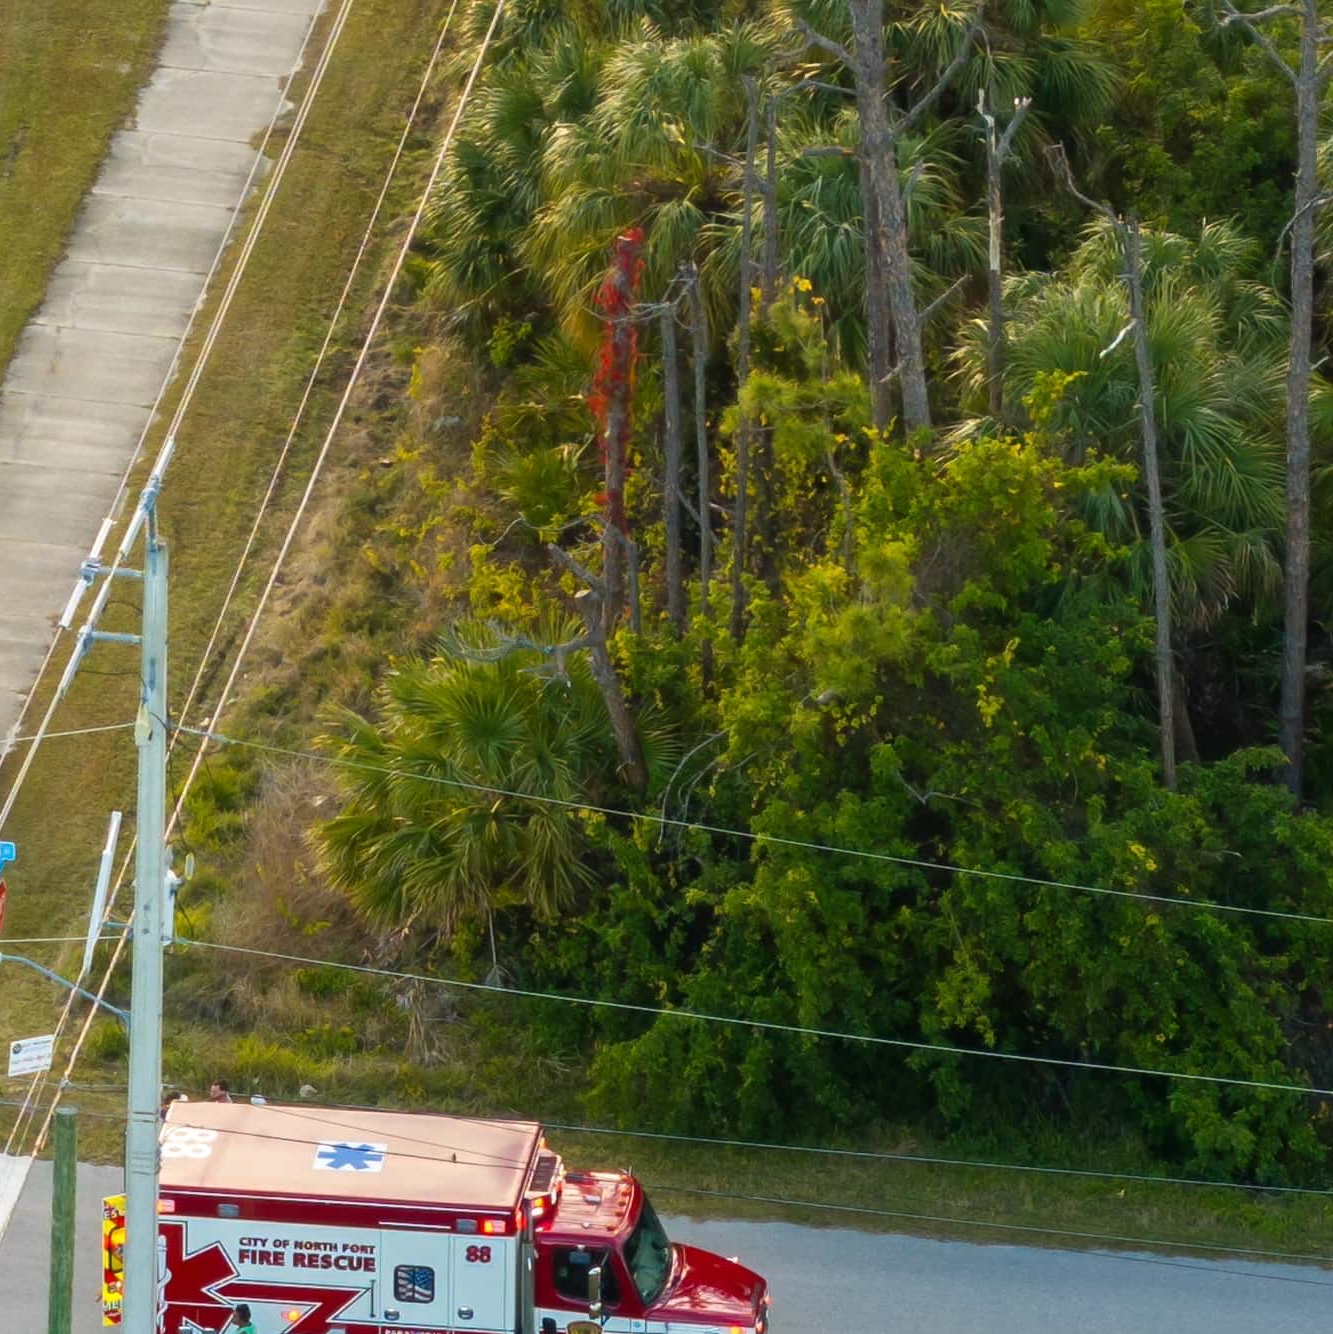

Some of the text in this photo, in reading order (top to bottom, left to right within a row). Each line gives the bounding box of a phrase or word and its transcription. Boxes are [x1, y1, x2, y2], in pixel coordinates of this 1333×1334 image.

[239, 1237, 268, 1248] CITY
[273, 1239, 290, 1249] OF
[294, 1240, 338, 1252] NORTH
[238, 1249, 376, 1273] FIRE RESCUE
[465, 1245, 492, 1263] 88
